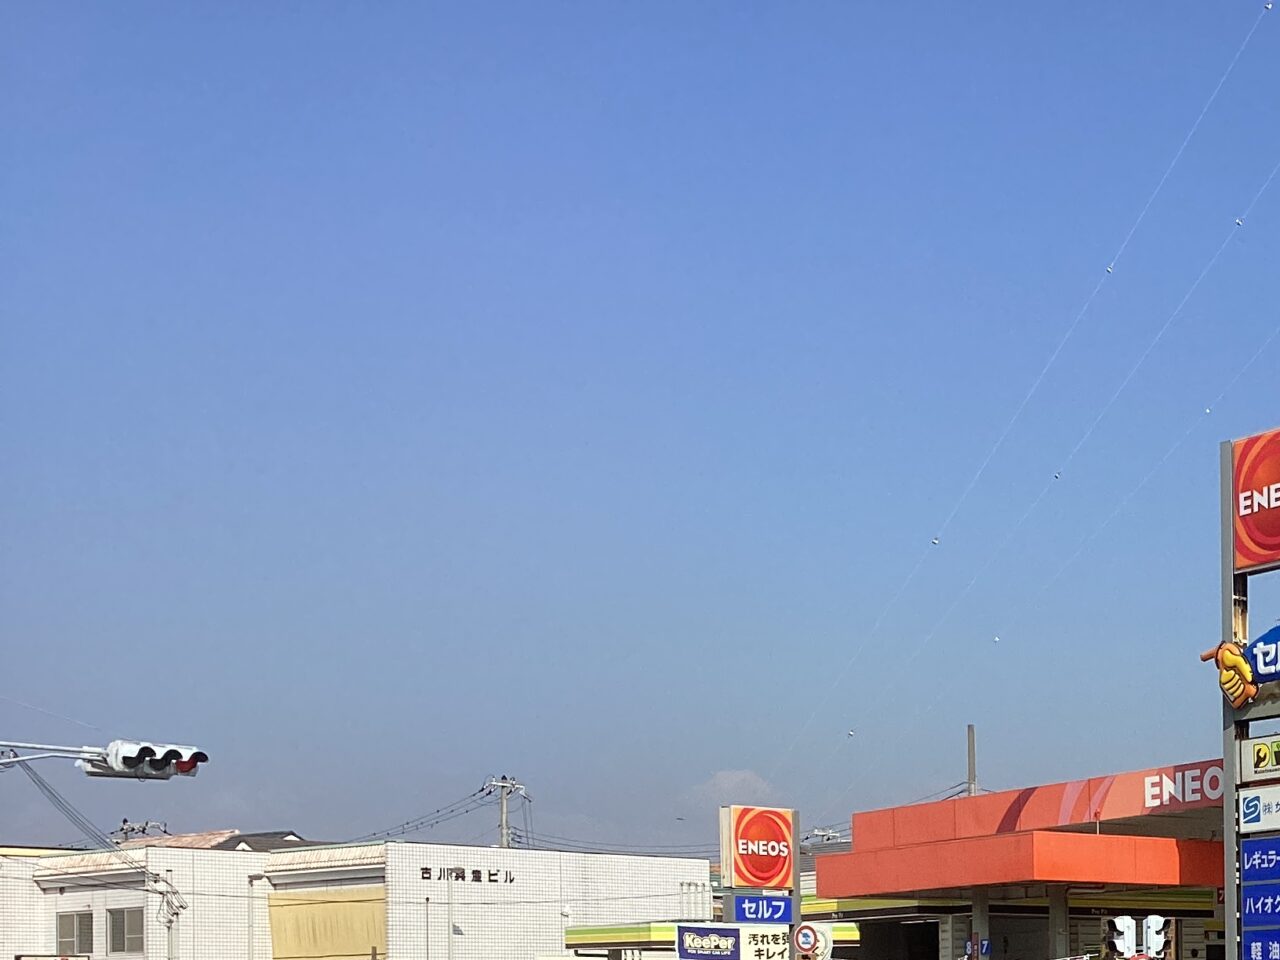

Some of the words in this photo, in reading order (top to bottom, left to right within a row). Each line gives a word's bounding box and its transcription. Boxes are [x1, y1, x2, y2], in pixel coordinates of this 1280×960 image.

[1144, 766, 1224, 808] ENEO
[738, 839, 788, 857] ENEOS
[742, 899, 786, 919] セルフ
[684, 933, 736, 950] KeePer
[982, 940, 988, 954] 7
[1251, 941, 1280, 960] 軽油
